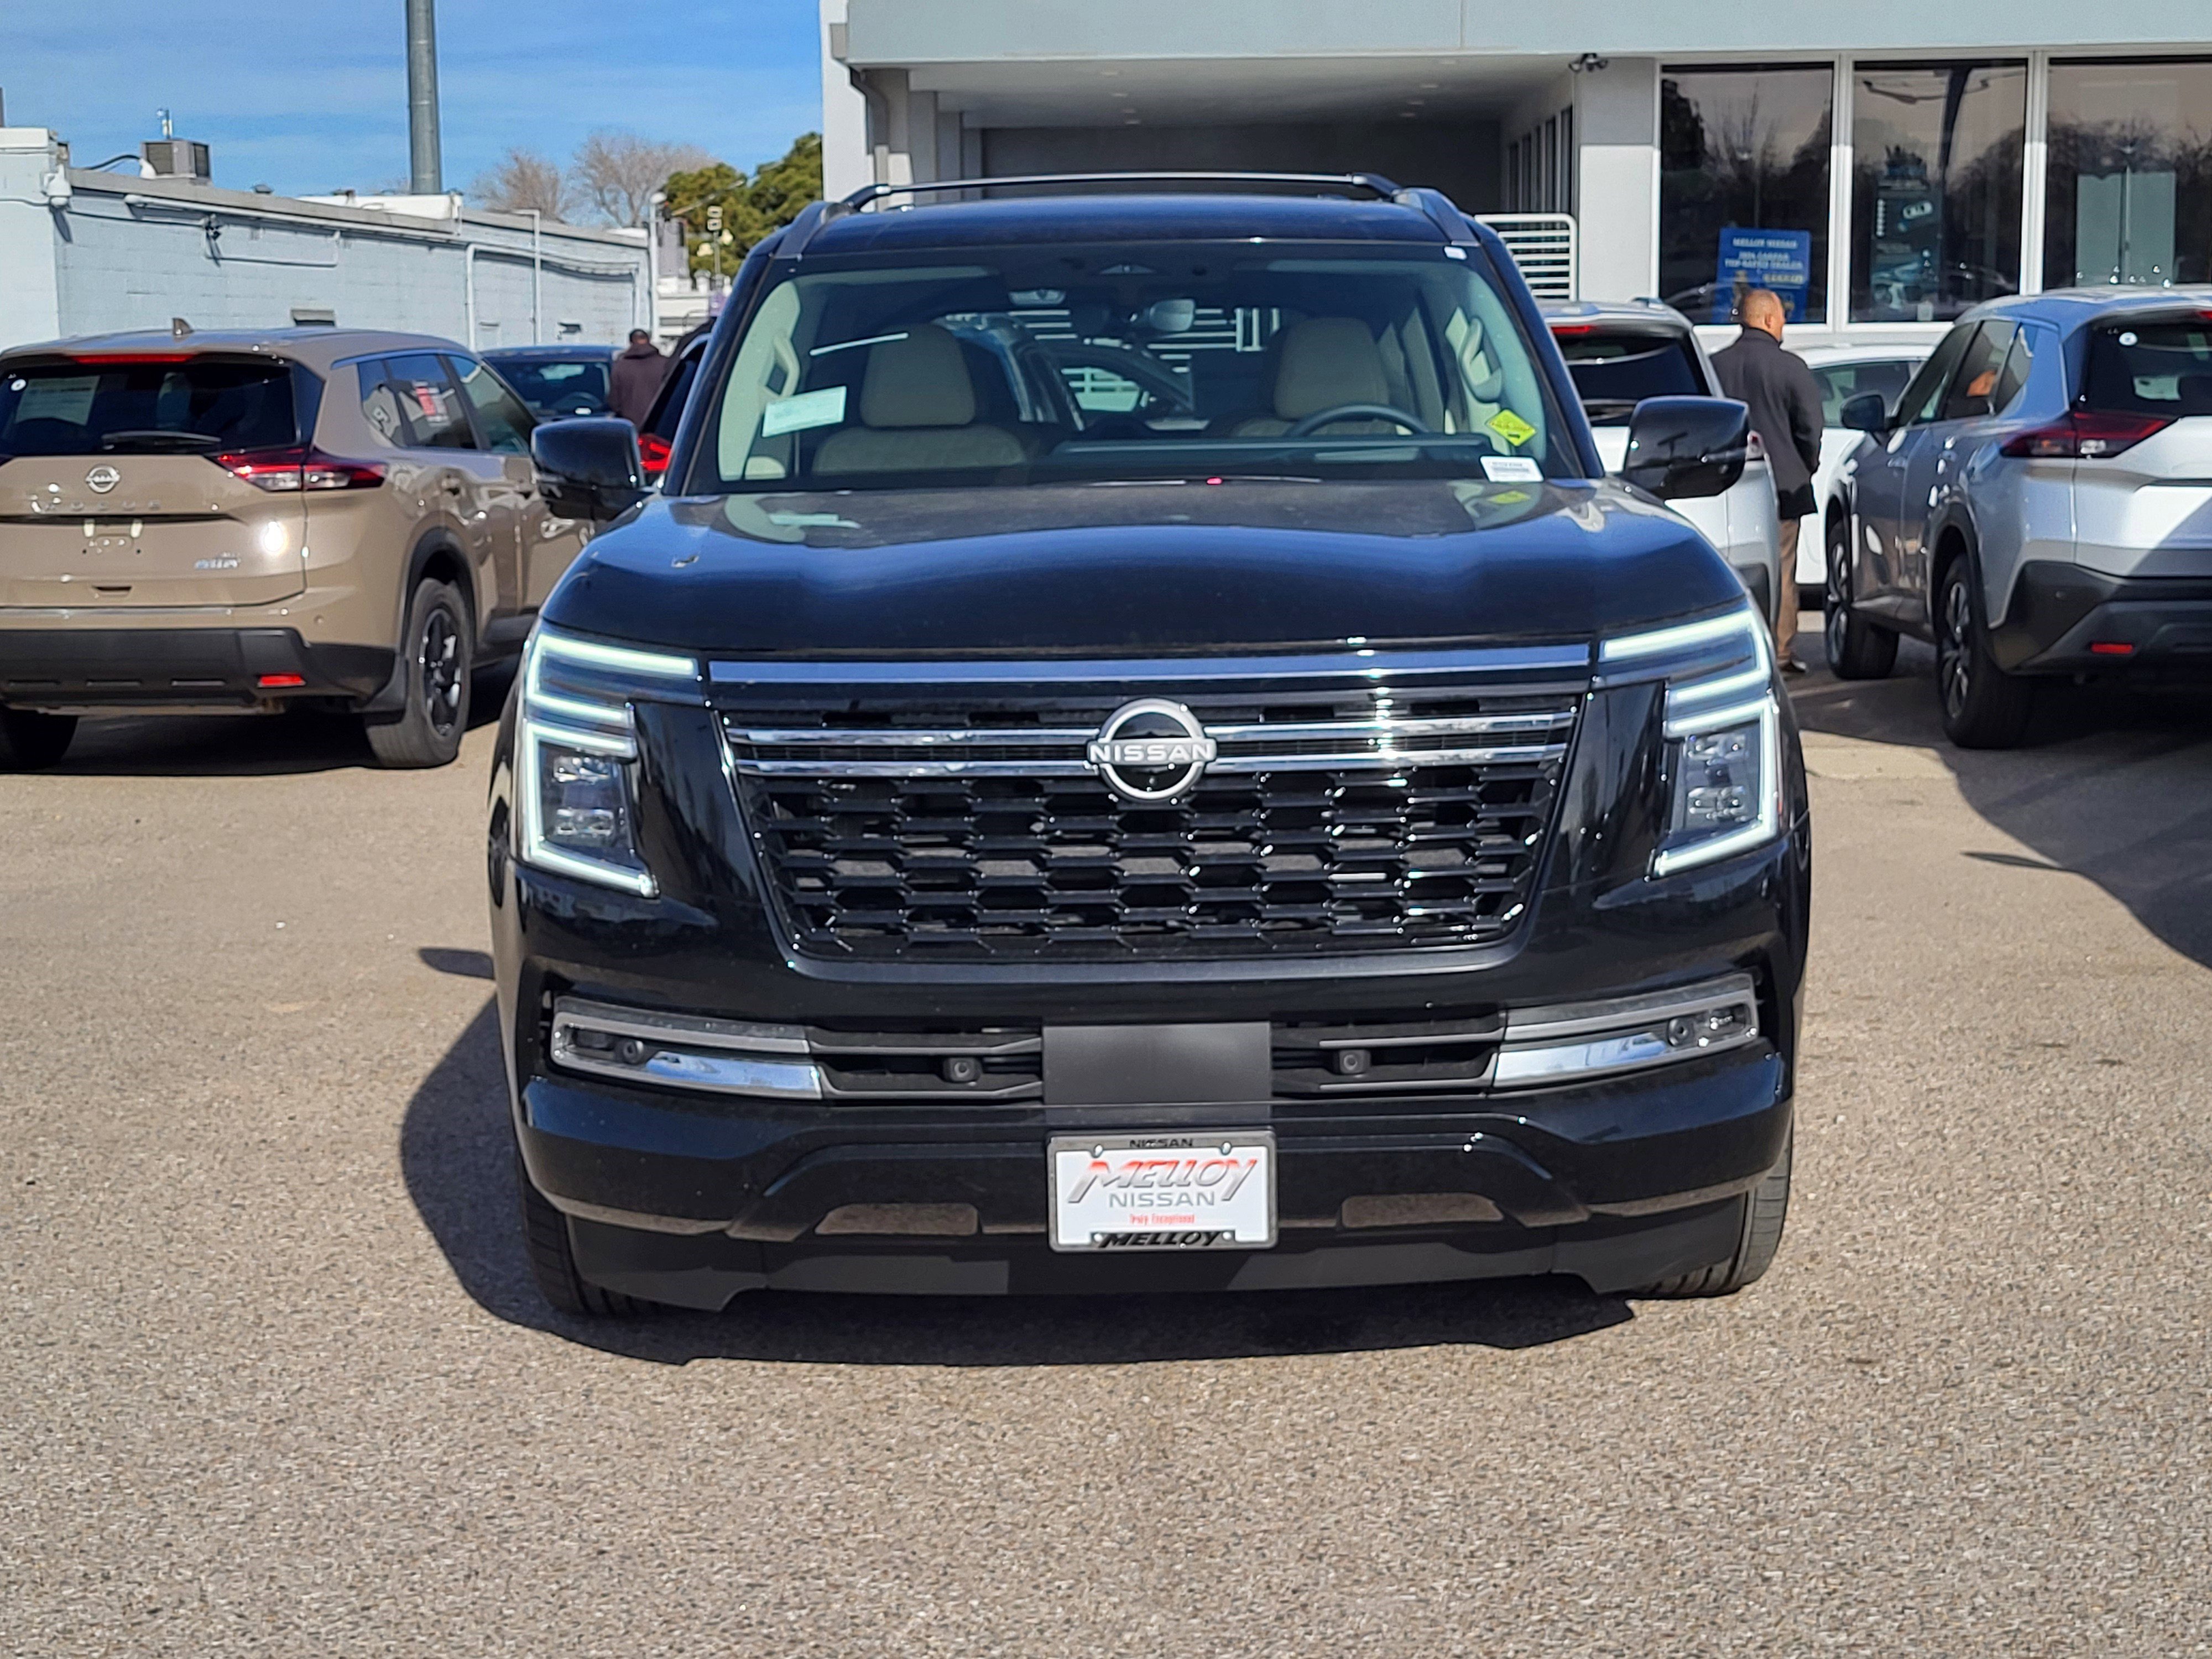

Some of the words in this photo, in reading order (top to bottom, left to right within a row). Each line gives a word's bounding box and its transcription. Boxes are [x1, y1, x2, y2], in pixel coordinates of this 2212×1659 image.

[1089, 744, 1211, 762] NISSAN
[1068, 1159, 1258, 1204] MELLOY
[1109, 1191, 1215, 1208] NISSAN
[1098, 1231, 1221, 1249] MELLOY
